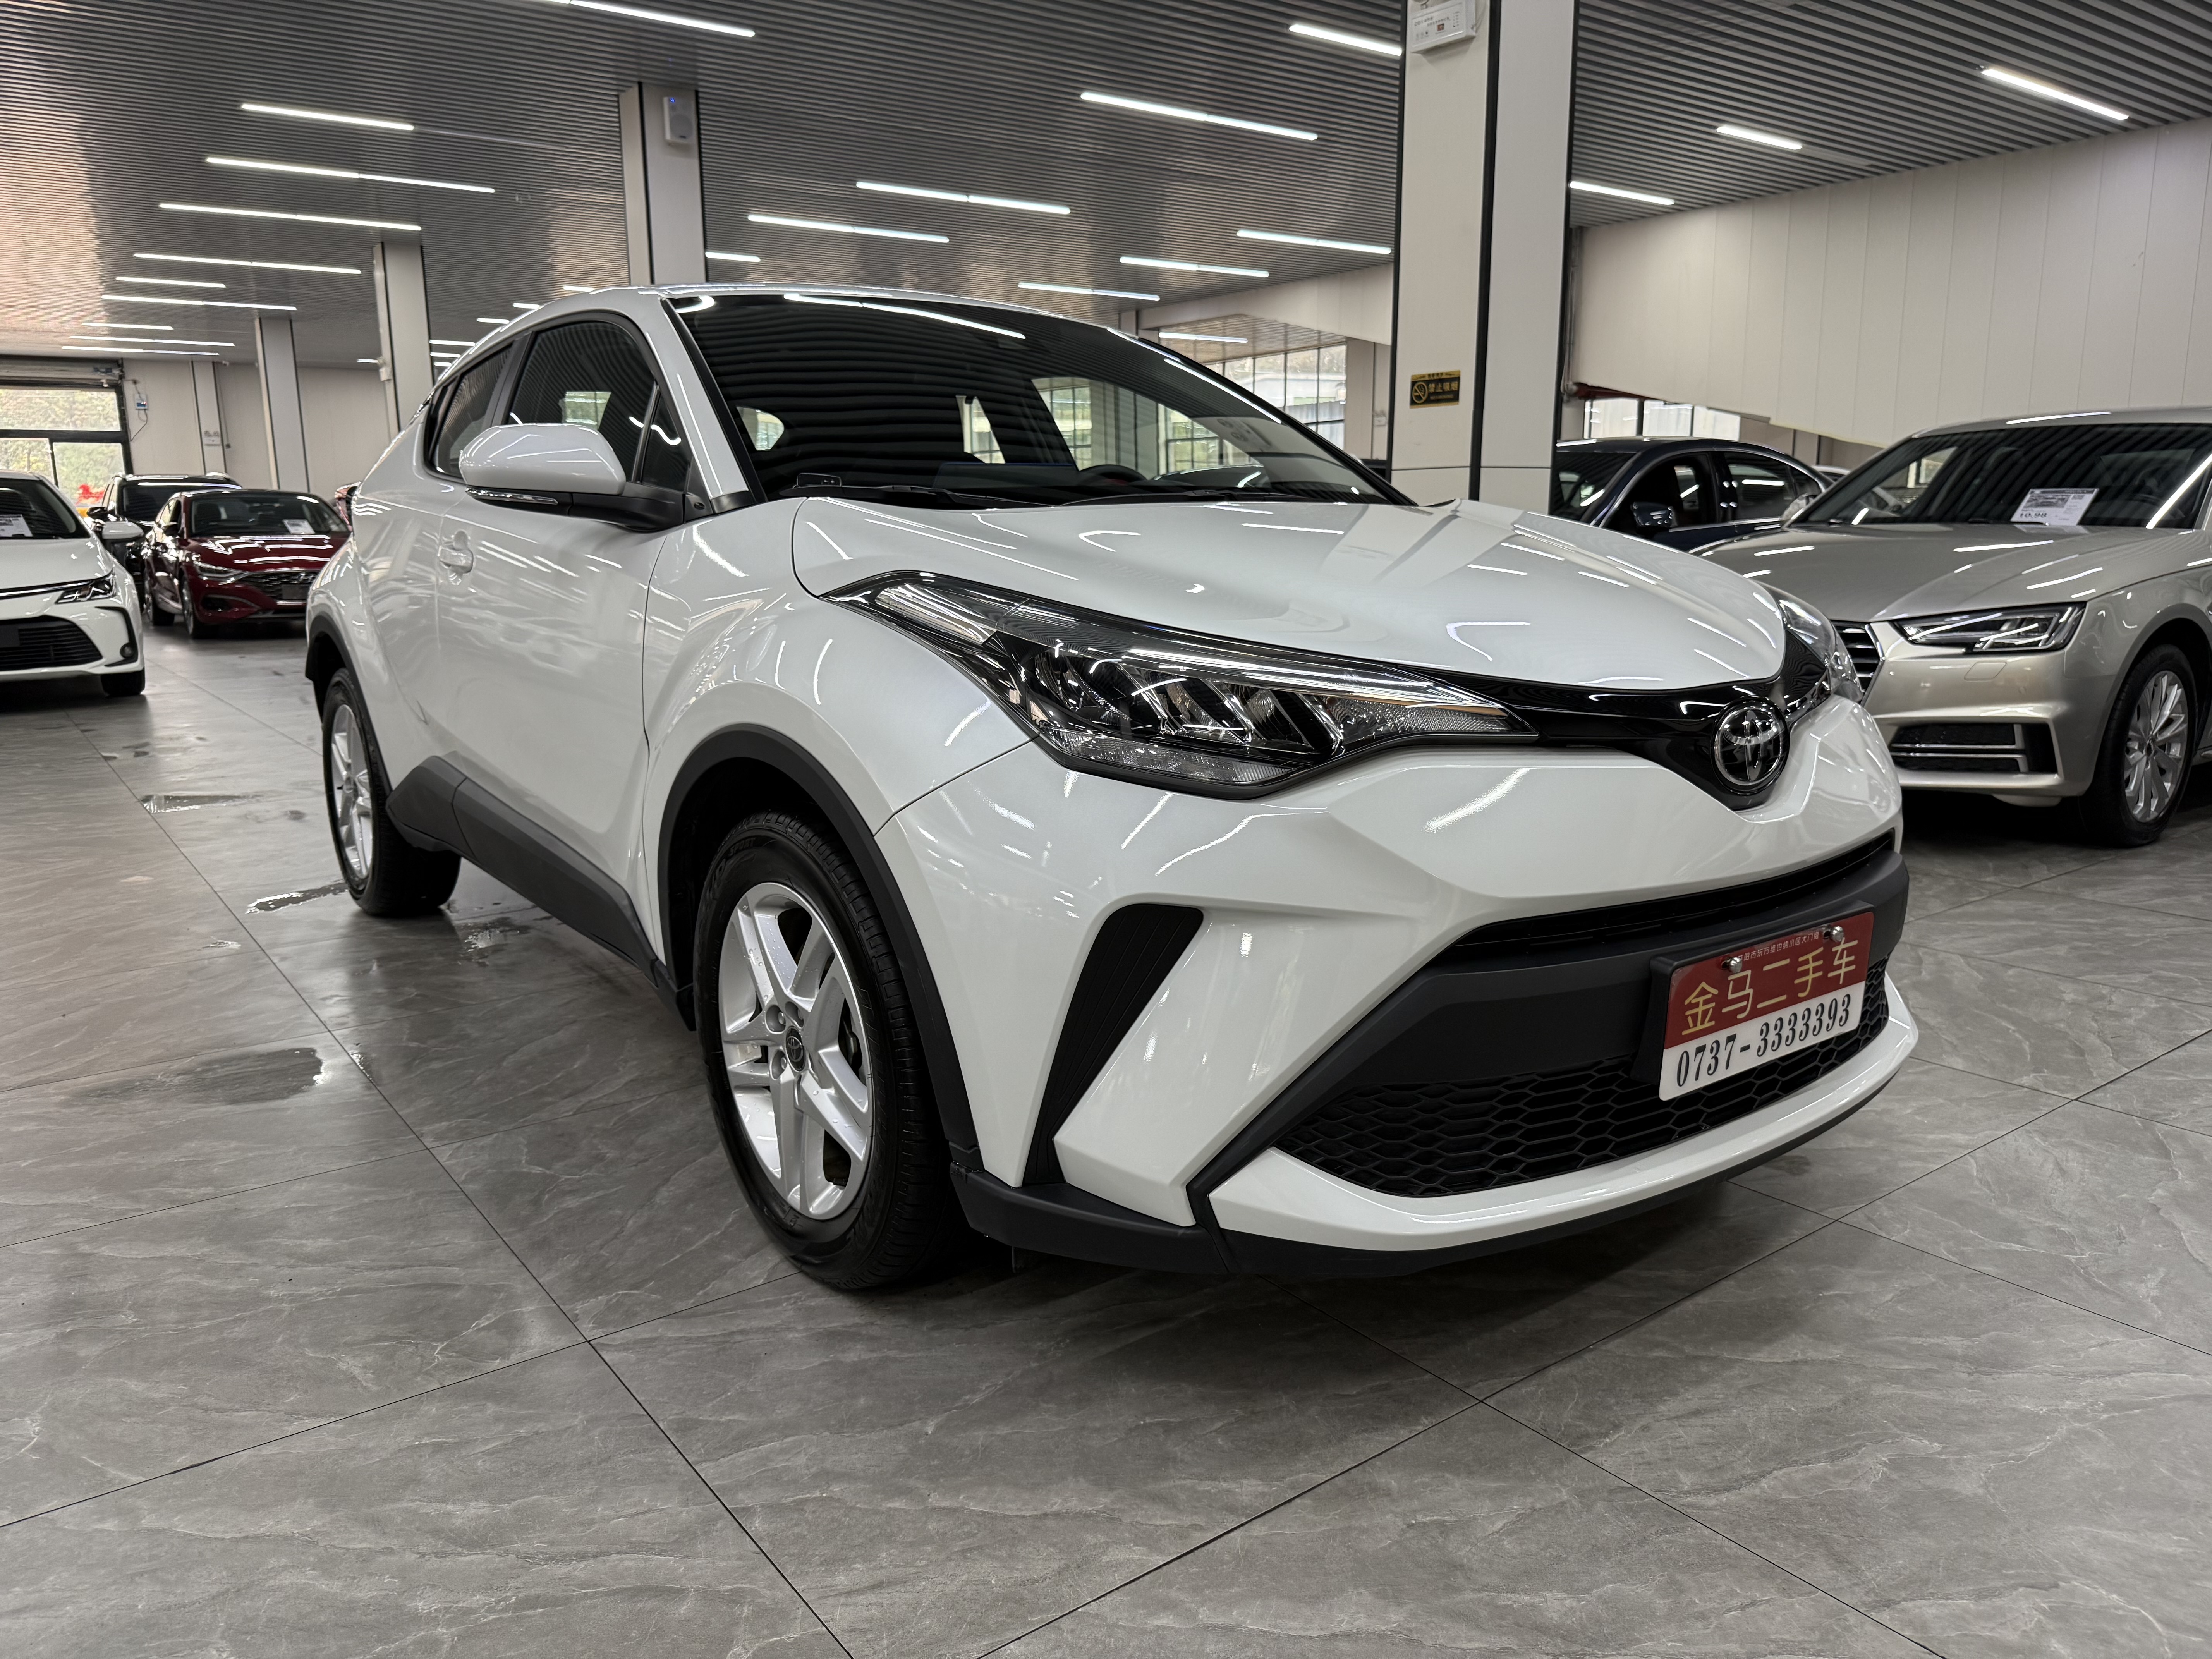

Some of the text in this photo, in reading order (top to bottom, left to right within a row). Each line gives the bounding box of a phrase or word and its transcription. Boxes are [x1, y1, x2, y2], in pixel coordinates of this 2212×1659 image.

[1681, 938, 1859, 1036] 金马二手车
[1677, 993, 1851, 1087] 0737-3333393
